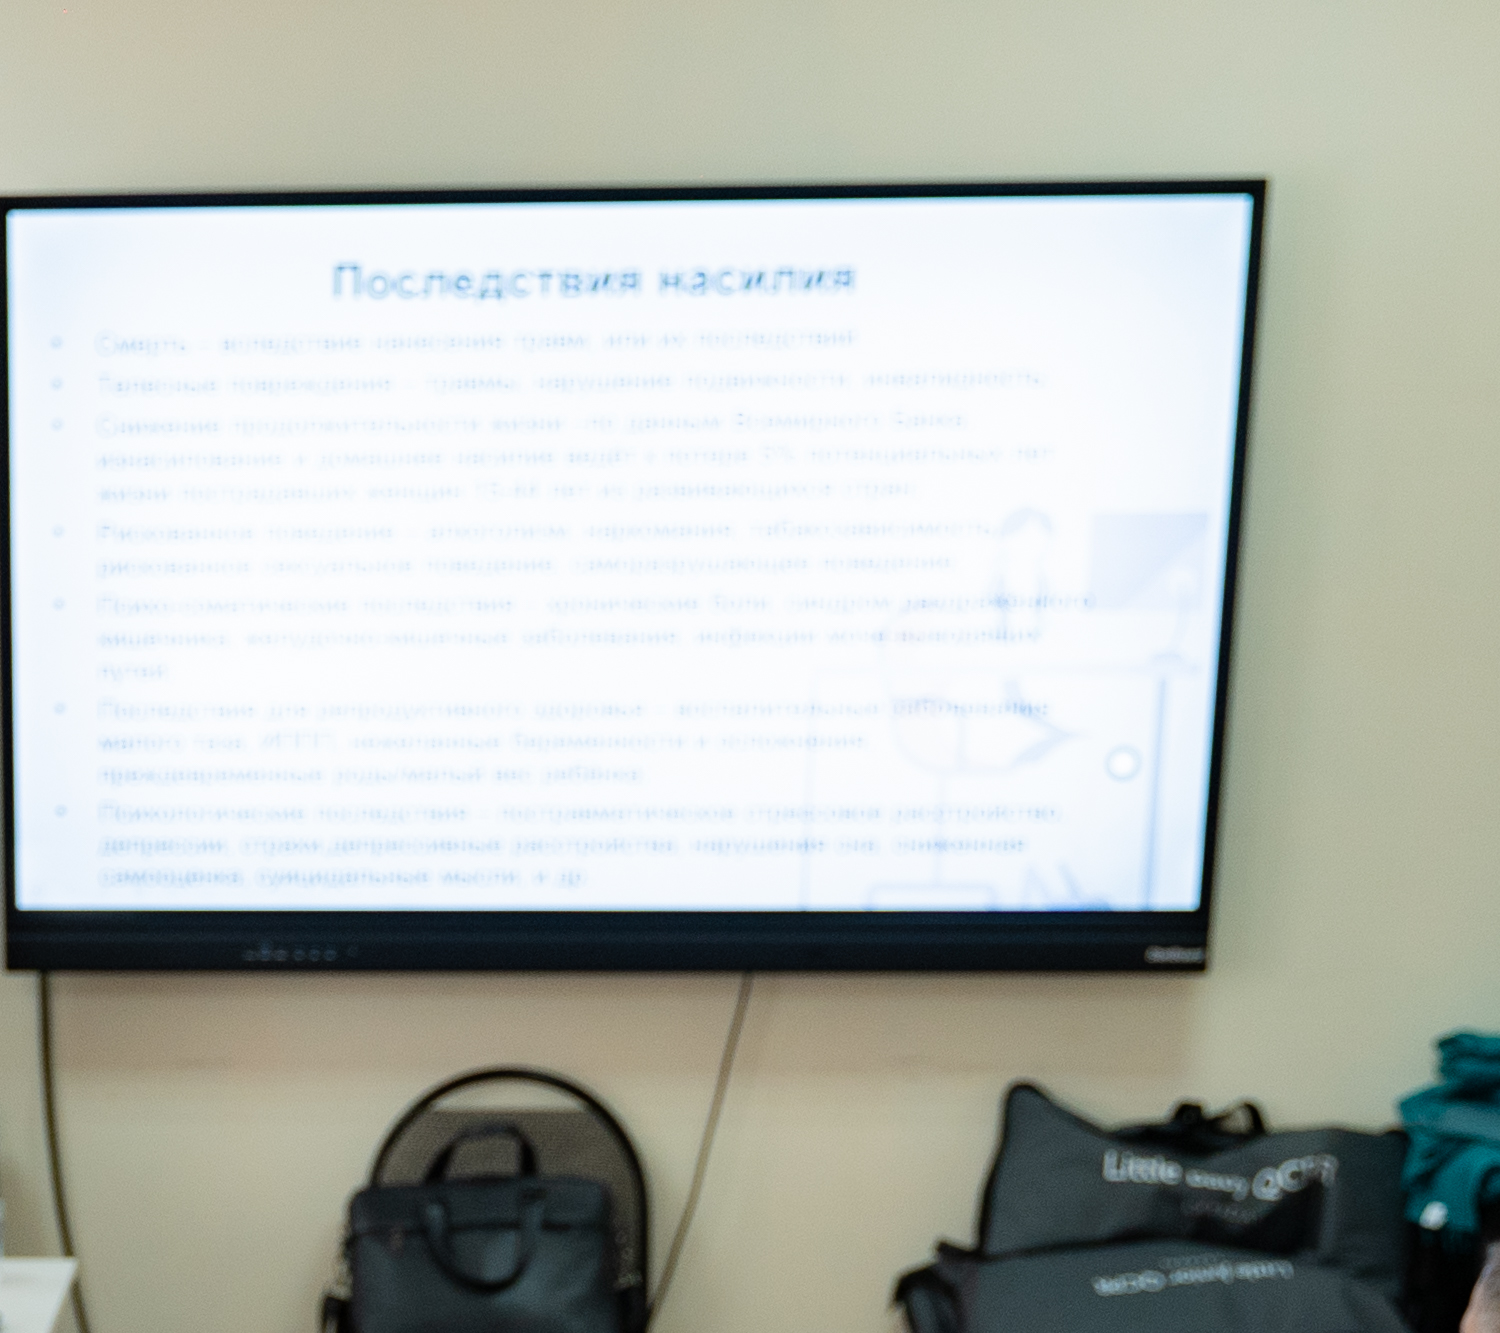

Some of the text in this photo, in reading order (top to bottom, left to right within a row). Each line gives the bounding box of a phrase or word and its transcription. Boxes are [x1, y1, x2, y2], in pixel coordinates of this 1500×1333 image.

[333, 263, 857, 305] Последствия насилия
[1102, 1149, 1184, 1186] Little
